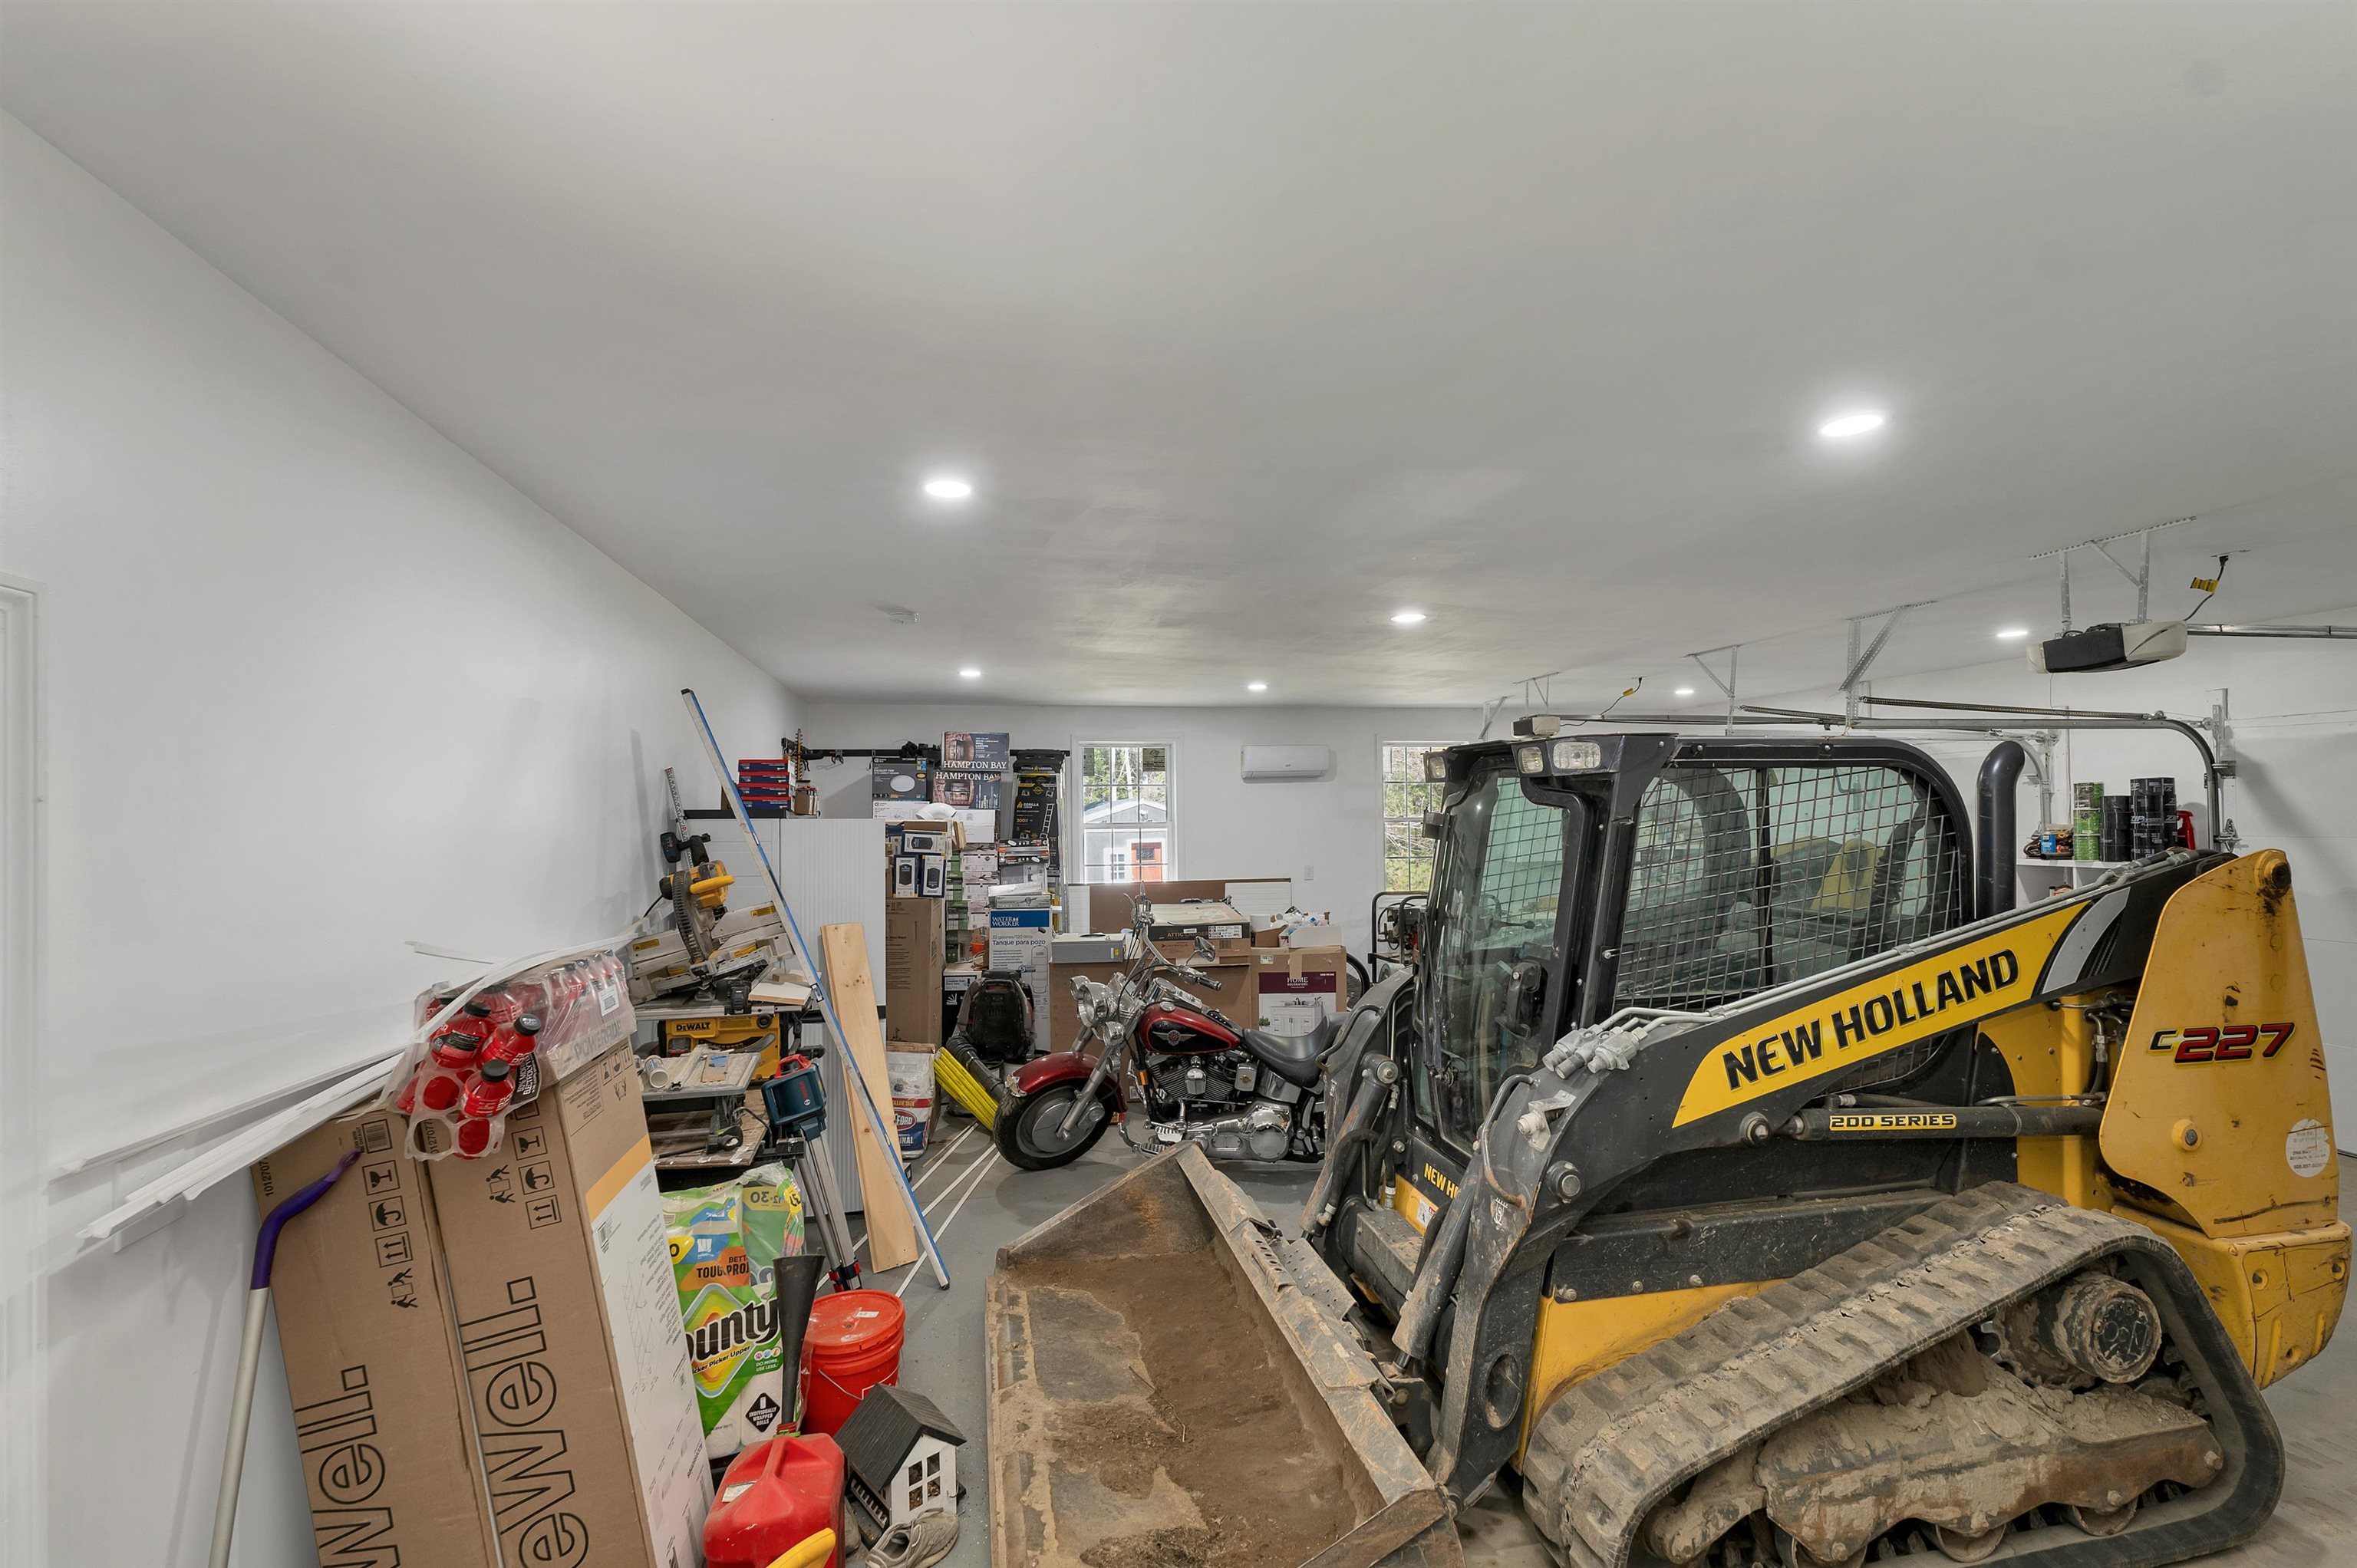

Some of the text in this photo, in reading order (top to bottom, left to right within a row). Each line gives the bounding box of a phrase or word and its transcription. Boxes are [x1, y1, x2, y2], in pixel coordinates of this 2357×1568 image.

[935, 772, 981, 780] HAMPTON
[1722, 949, 2019, 1092] NEW HOLLAND
[523, 1056, 533, 1095] ELECTROLYT
[895, 1114, 913, 1126] FORD
[1830, 1115, 1956, 1128] 200 SERIES
[1423, 1162, 1447, 1191] NEW
[709, 1354, 730, 1367] Picker
[730, 1346, 750, 1359] Upper
[749, 1406, 776, 1418] INDIVIDUALLY
[753, 1413, 773, 1422] WRAPPED
